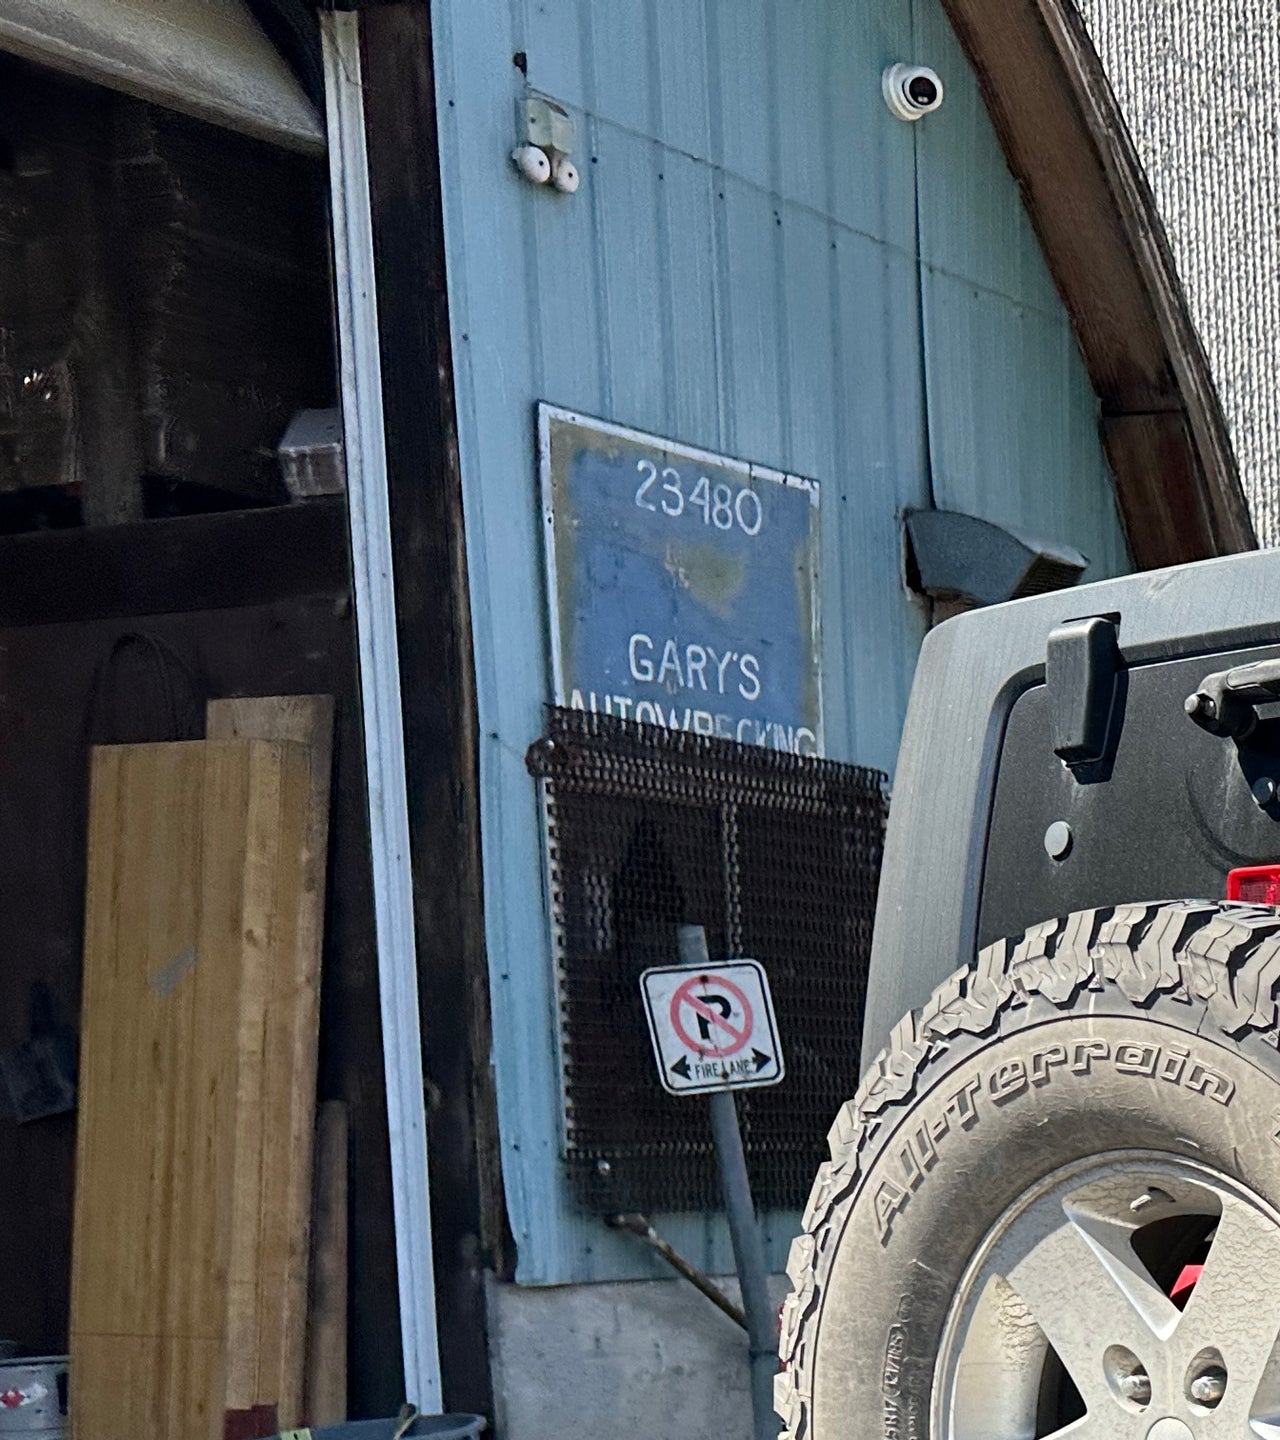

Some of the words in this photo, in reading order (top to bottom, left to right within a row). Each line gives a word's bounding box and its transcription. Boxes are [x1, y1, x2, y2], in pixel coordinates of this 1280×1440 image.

[635, 458, 764, 537] 23480
[628, 632, 762, 702] GARY'S
[694, 1060, 718, 1080] FIRE
[721, 1058, 752, 1077] LANE
